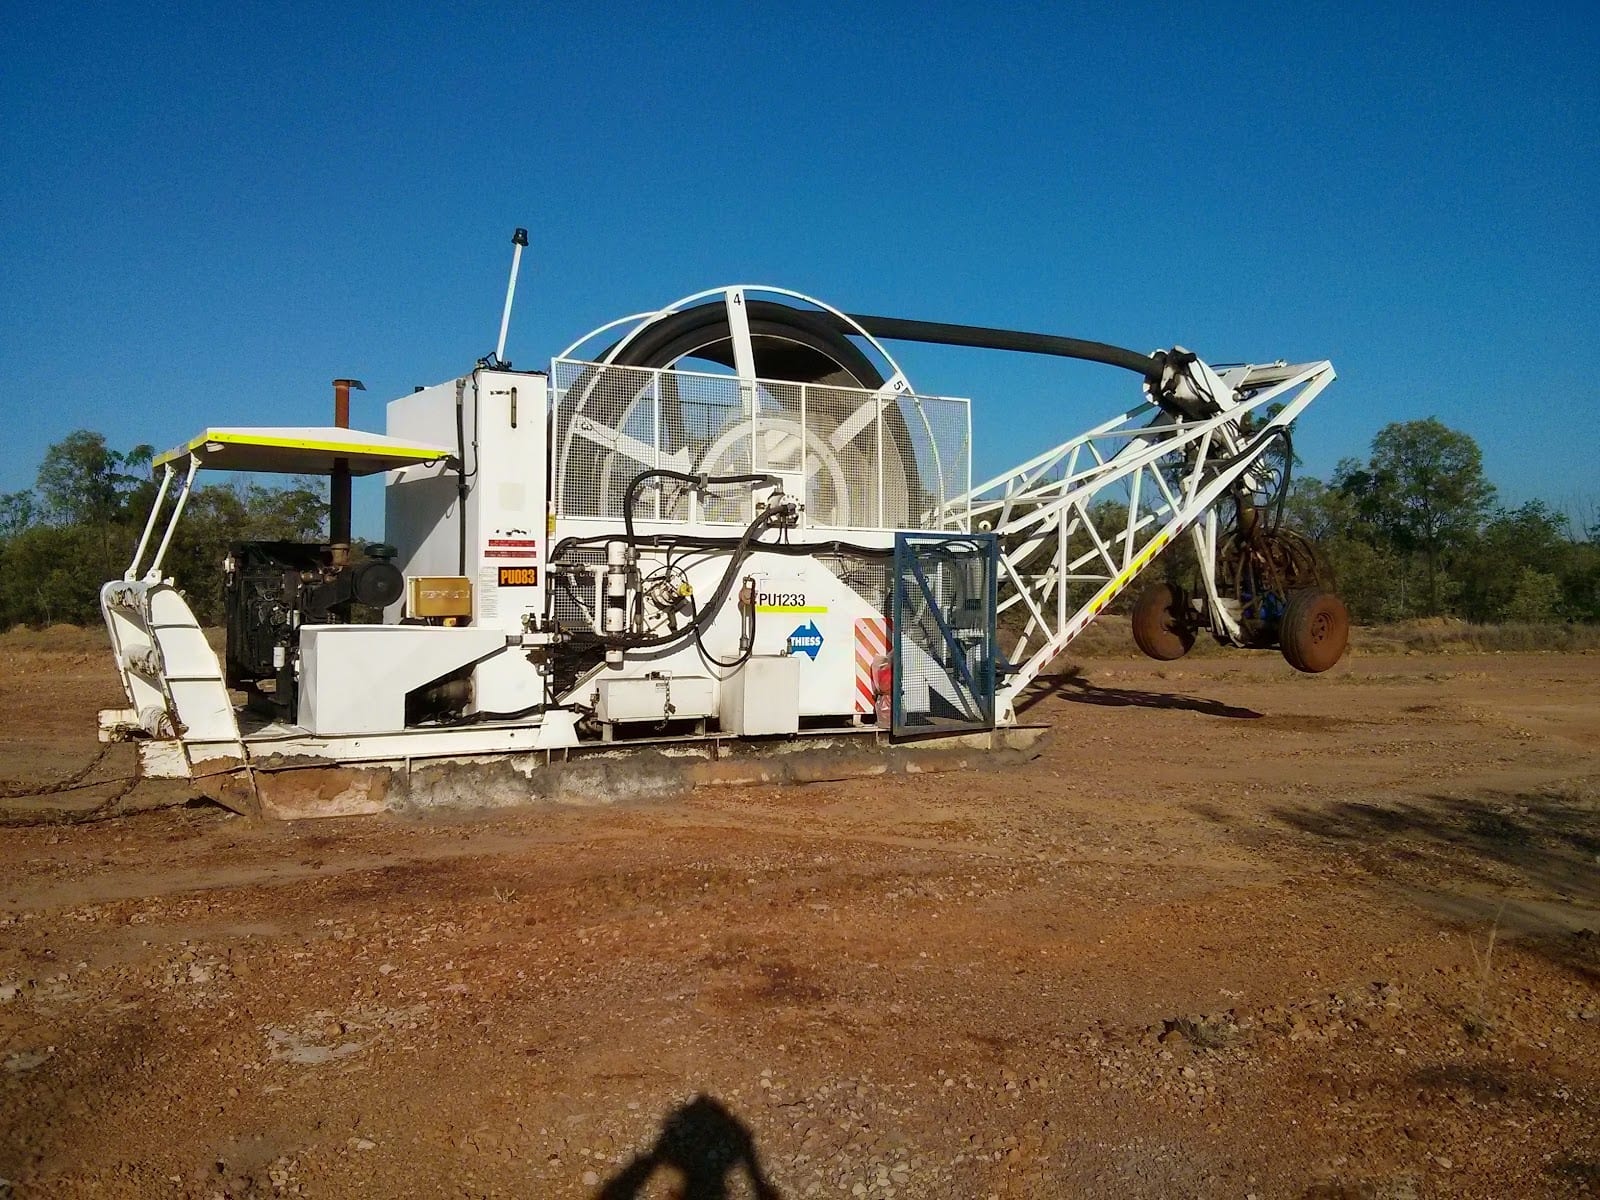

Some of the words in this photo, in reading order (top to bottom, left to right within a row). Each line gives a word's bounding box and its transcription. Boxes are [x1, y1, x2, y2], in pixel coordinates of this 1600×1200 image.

[733, 293, 741, 306] 4
[893, 380, 903, 390] 5
[501, 569, 535, 584] PU083
[759, 593, 805, 606] PU1233
[790, 636, 821, 646] THIESS
